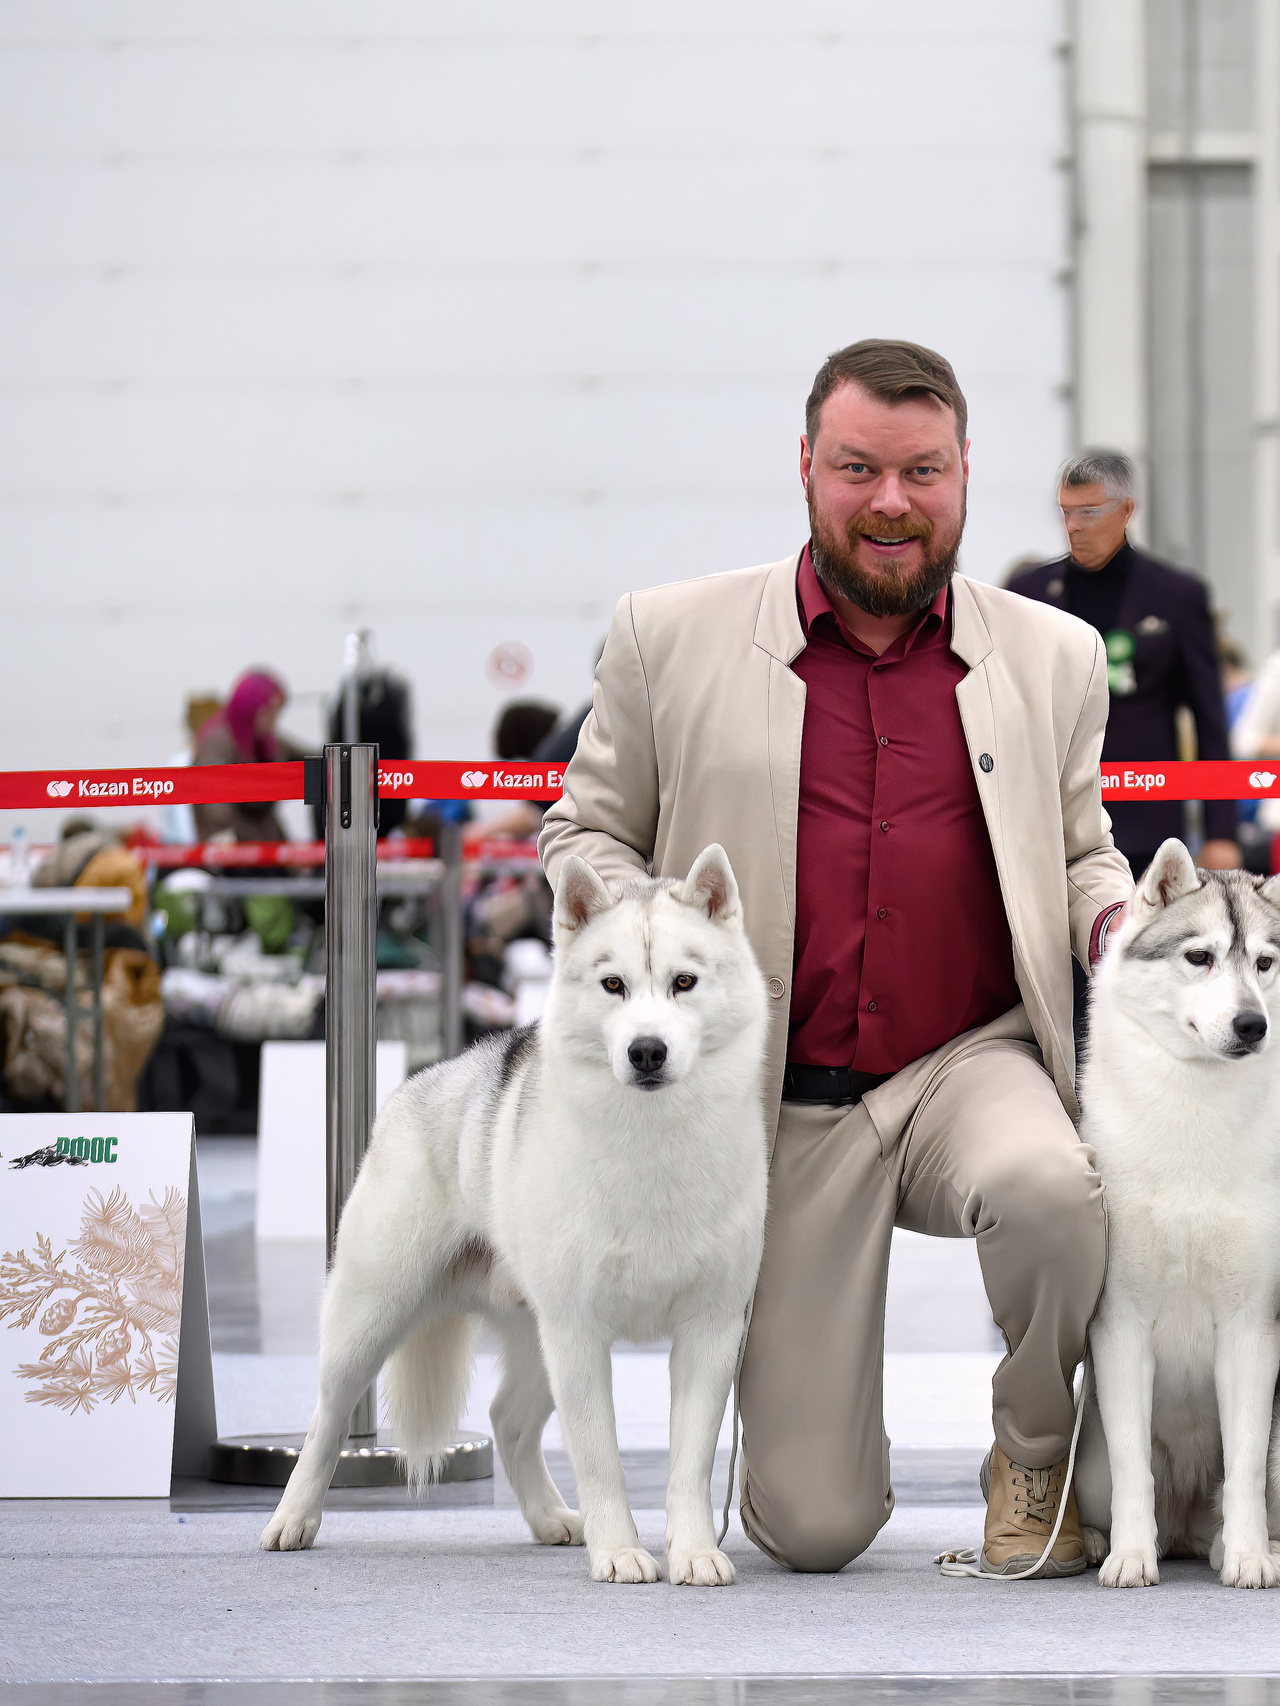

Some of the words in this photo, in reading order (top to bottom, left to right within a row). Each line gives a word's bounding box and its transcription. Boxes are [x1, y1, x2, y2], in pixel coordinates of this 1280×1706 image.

[78, 779, 129, 797] Kazan
[132, 777, 174, 799] Expo
[493, 770, 543, 788] Kazan
[1123, 770, 1166, 792] Expo
